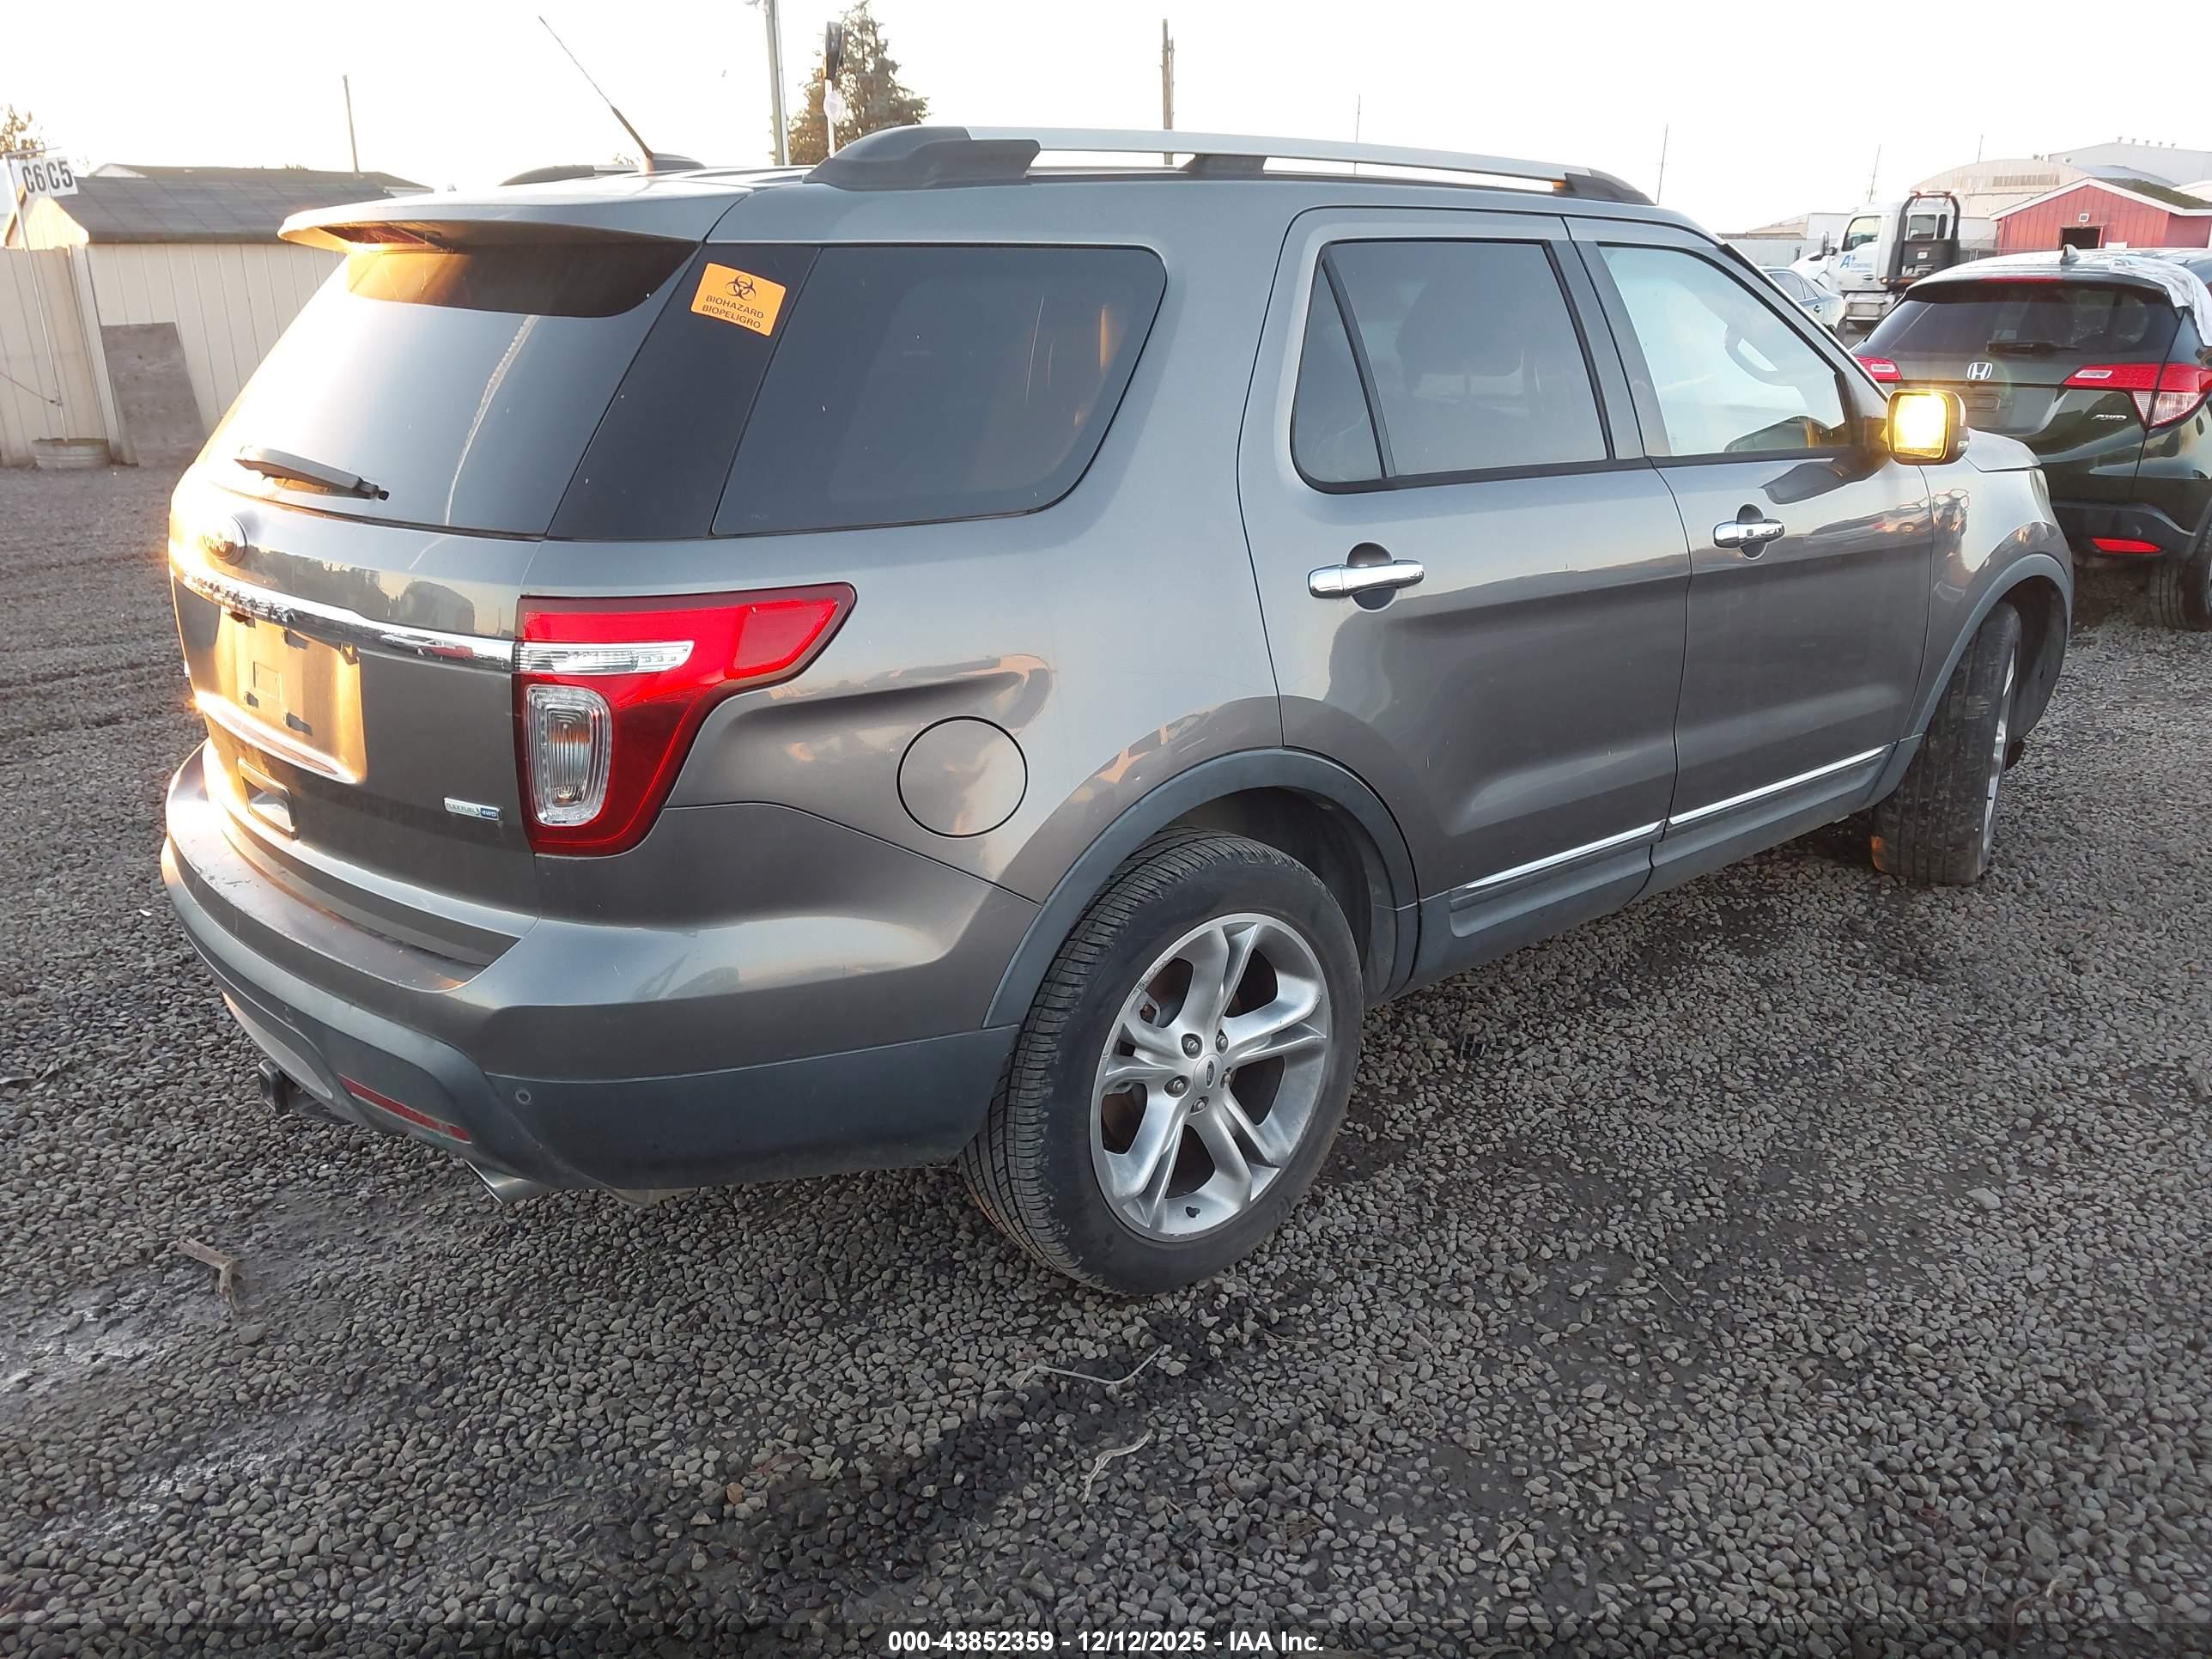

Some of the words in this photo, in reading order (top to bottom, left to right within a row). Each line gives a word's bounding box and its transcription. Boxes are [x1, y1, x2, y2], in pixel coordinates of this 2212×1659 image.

[22, 164, 46, 192] C6
[46, 161, 73, 189] C5
[702, 304, 761, 329] BIOPELIGRO
[706, 295, 763, 319] BIOHAZARD
